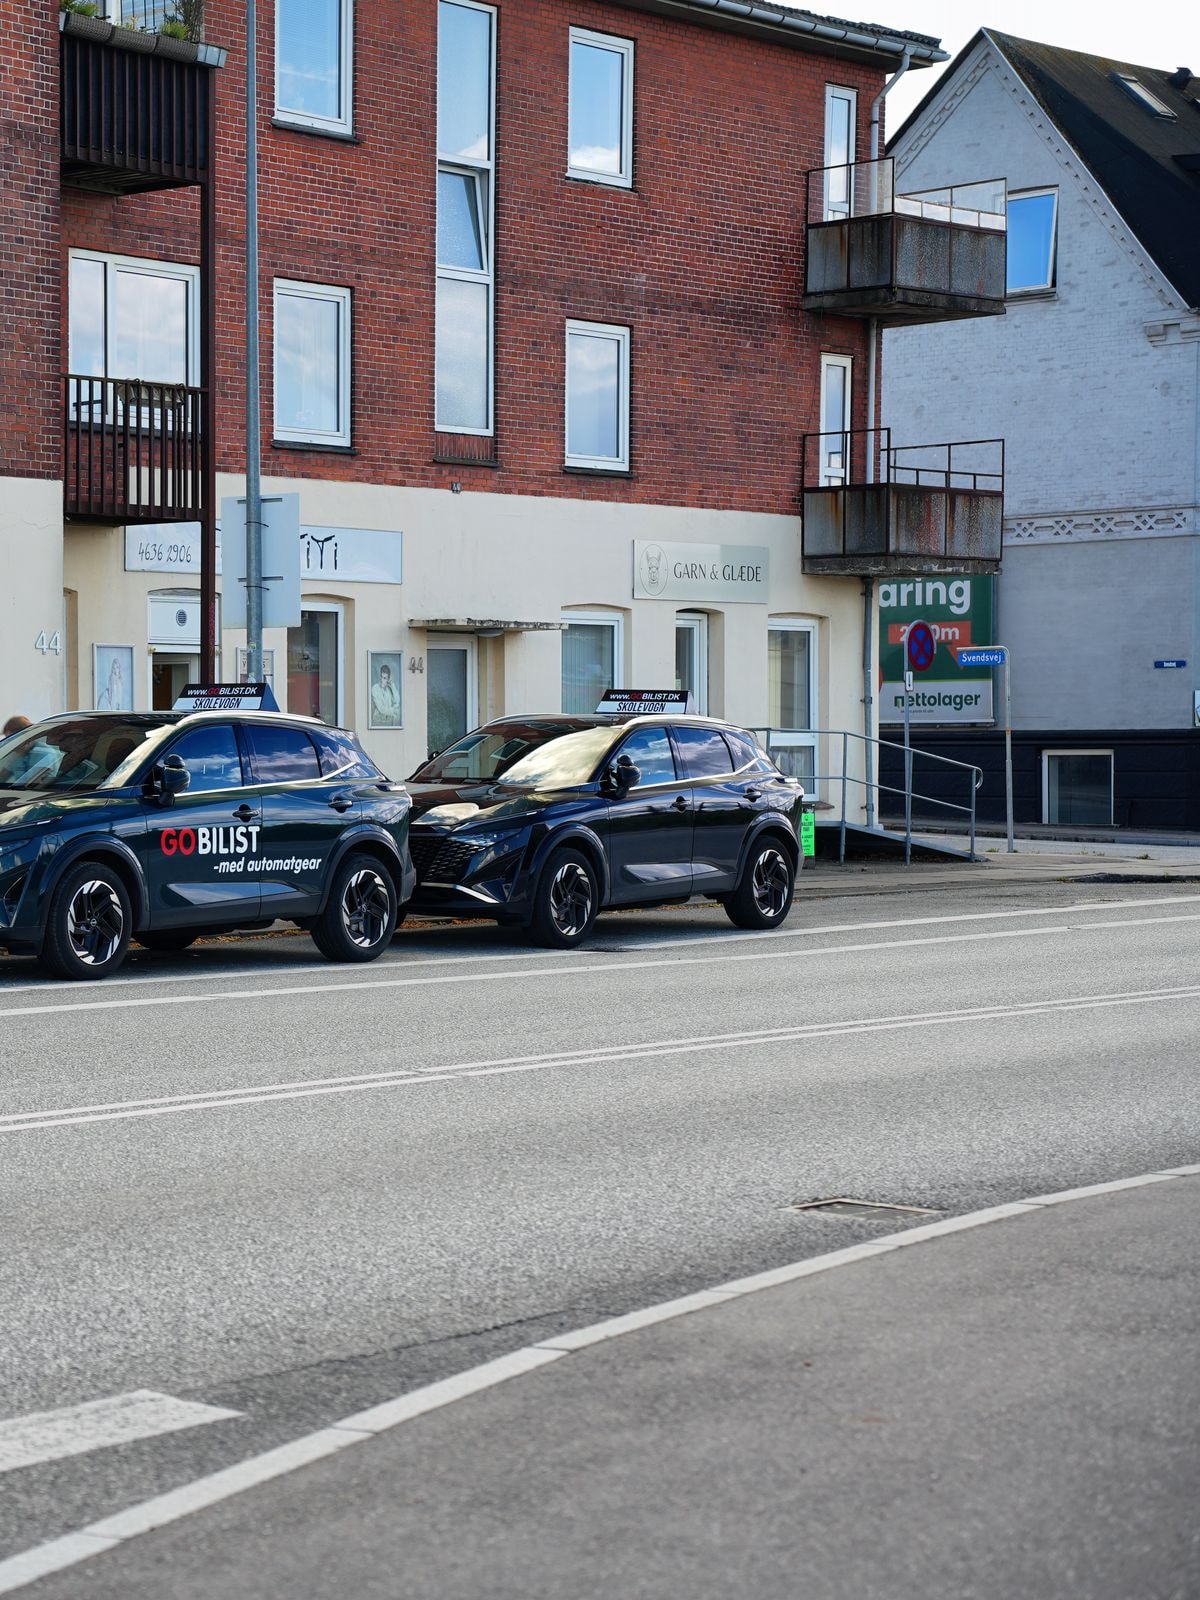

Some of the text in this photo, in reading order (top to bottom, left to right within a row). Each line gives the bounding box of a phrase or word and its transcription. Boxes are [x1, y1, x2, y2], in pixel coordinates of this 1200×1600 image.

[138, 542, 192, 563] 4636 2906
[673, 562, 762, 582] GARN & GLÆDE
[879, 578, 971, 615] aring
[899, 624, 960, 642] 20m
[34, 630, 61, 656] 44
[408, 656, 425, 674] 44
[962, 652, 1002, 664] Svendsvej
[187, 687, 258, 696] www.GOBILIST.DK
[609, 693, 681, 701] www.GOBILIST.DK
[192, 698, 243, 709] SKOLEVOGN
[616, 702, 666, 712] SKOLEVOGN
[894, 692, 981, 711] nettolager
[160, 826, 261, 856] GOBILIST
[213, 856, 322, 874] -med automatgear
